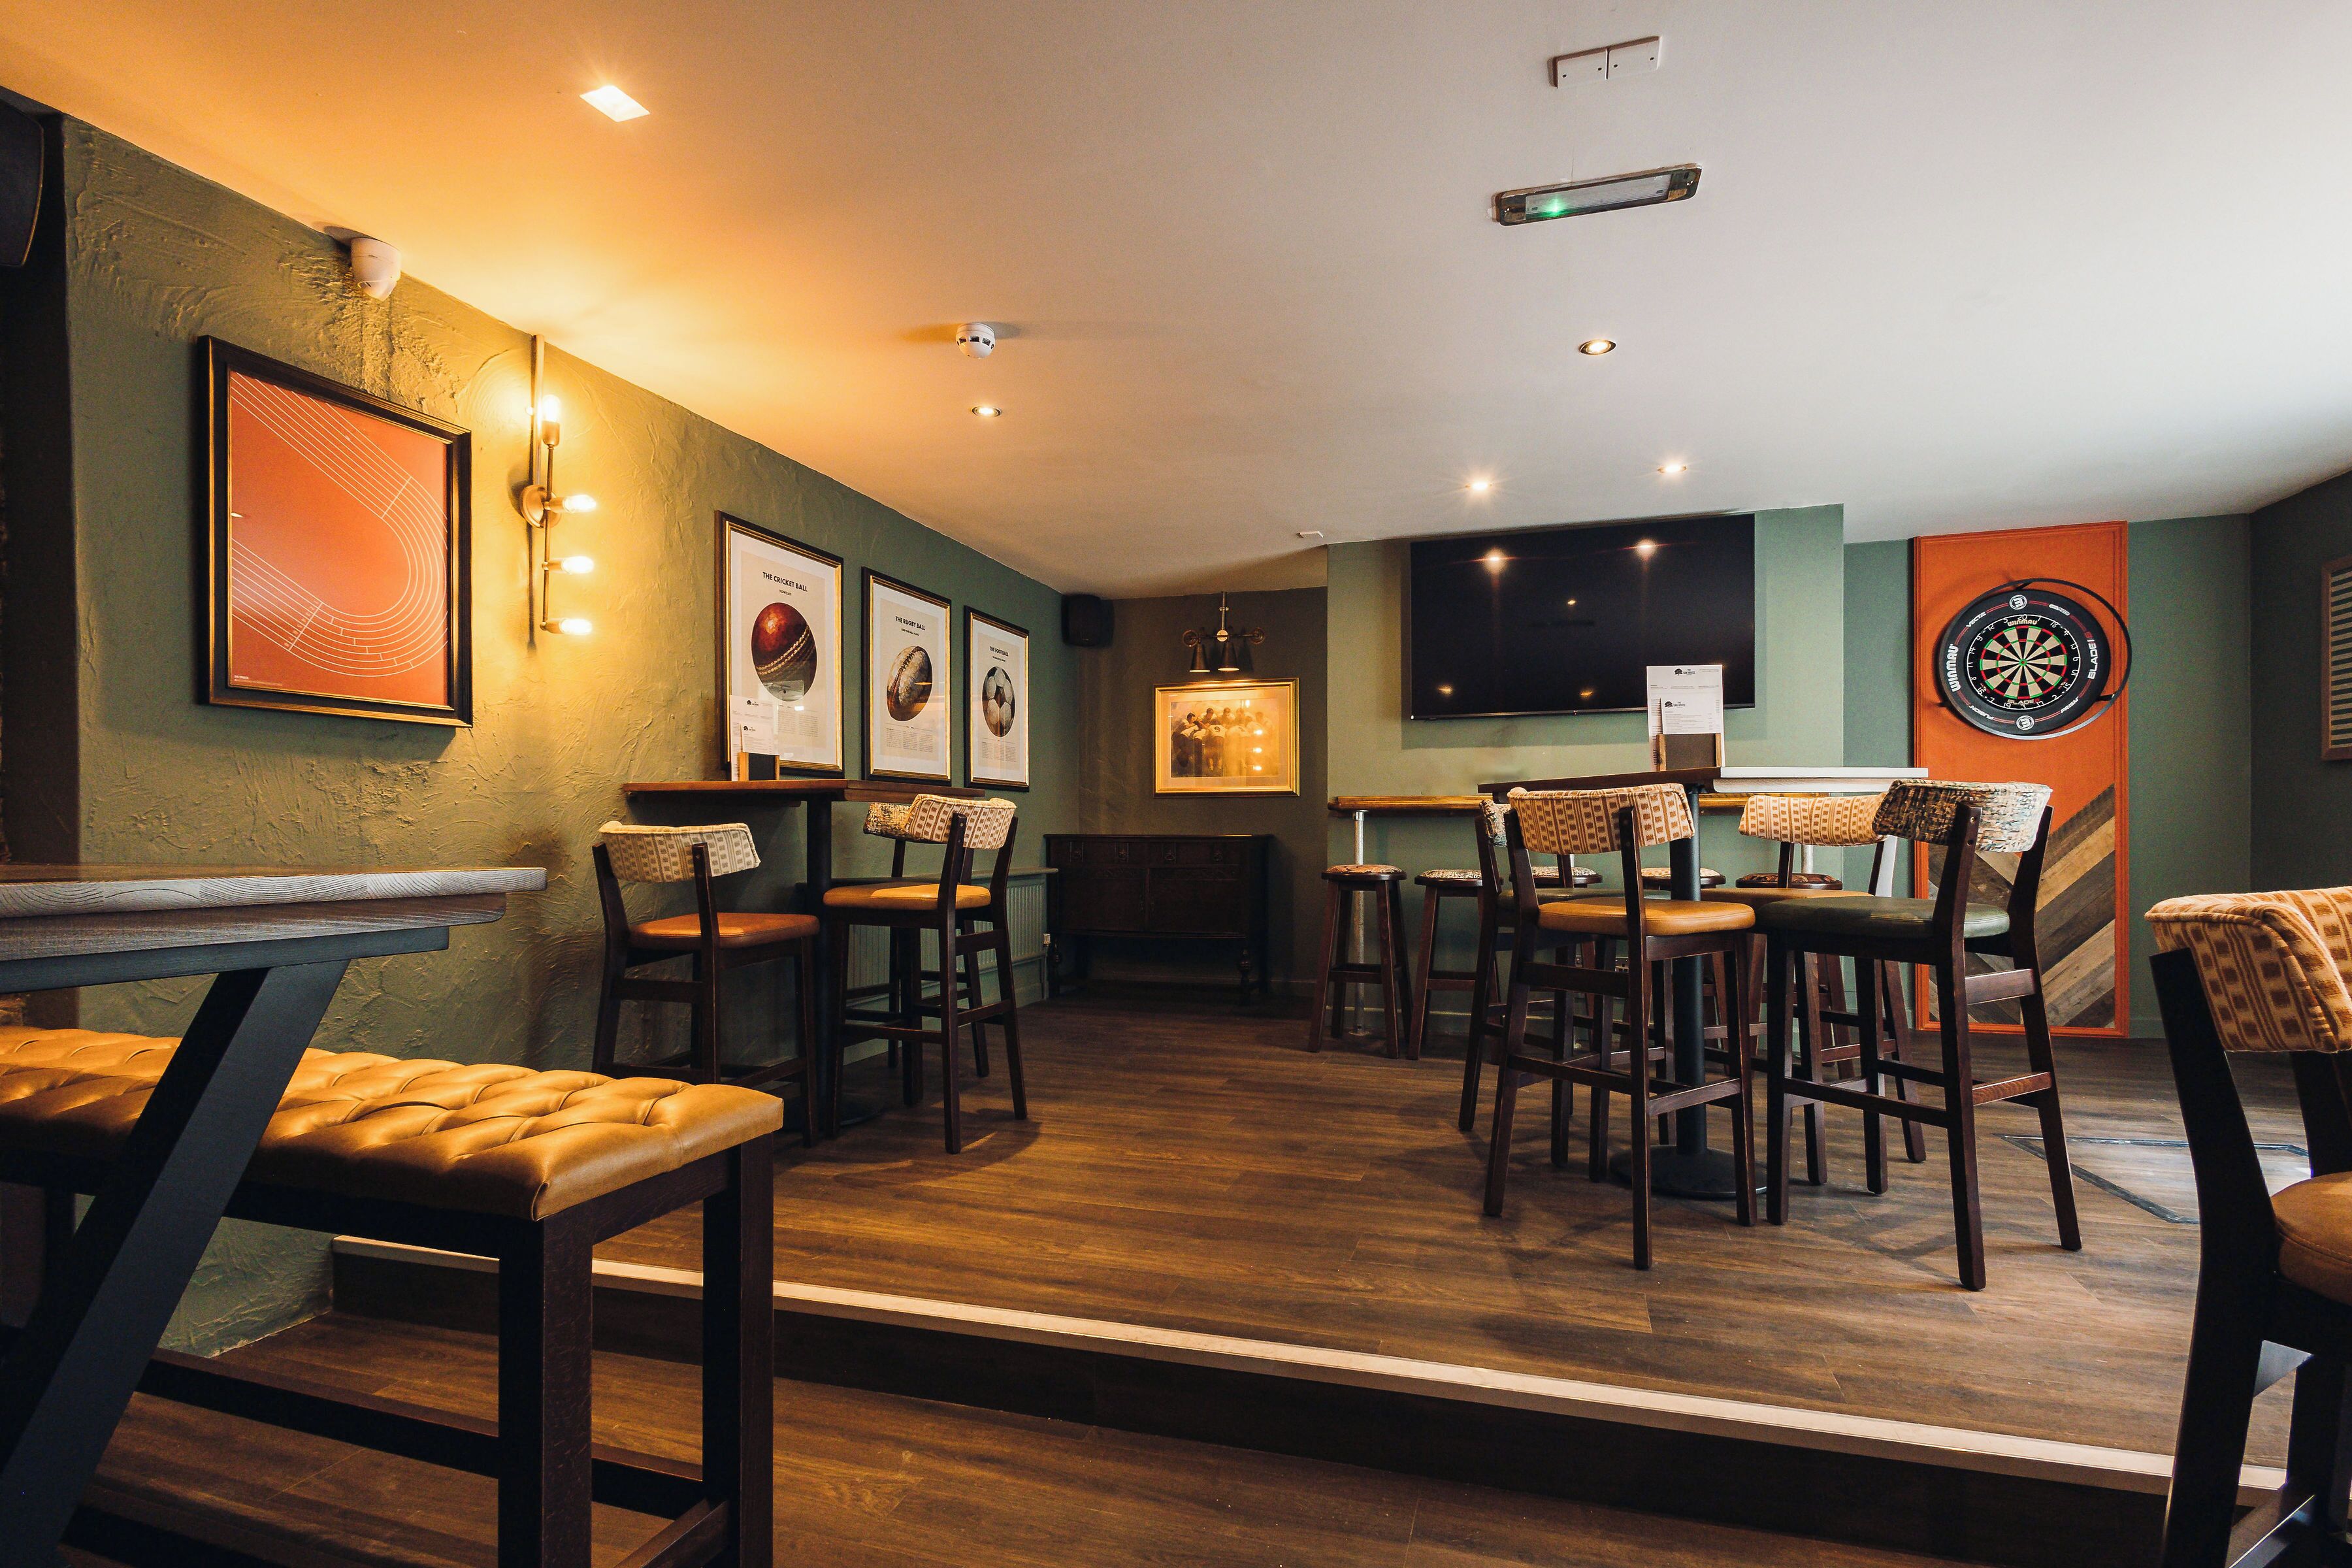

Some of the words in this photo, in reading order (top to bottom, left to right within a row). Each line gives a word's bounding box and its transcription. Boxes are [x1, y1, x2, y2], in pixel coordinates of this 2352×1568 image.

[762, 572, 773, 581] THE
[774, 576, 794, 587] CRICKET
[795, 582, 808, 592] BALL
[903, 619, 916, 627] RUGBY
[995, 648, 1009, 657] FOOTBALL
[1946, 644, 1961, 692] WINMAU
